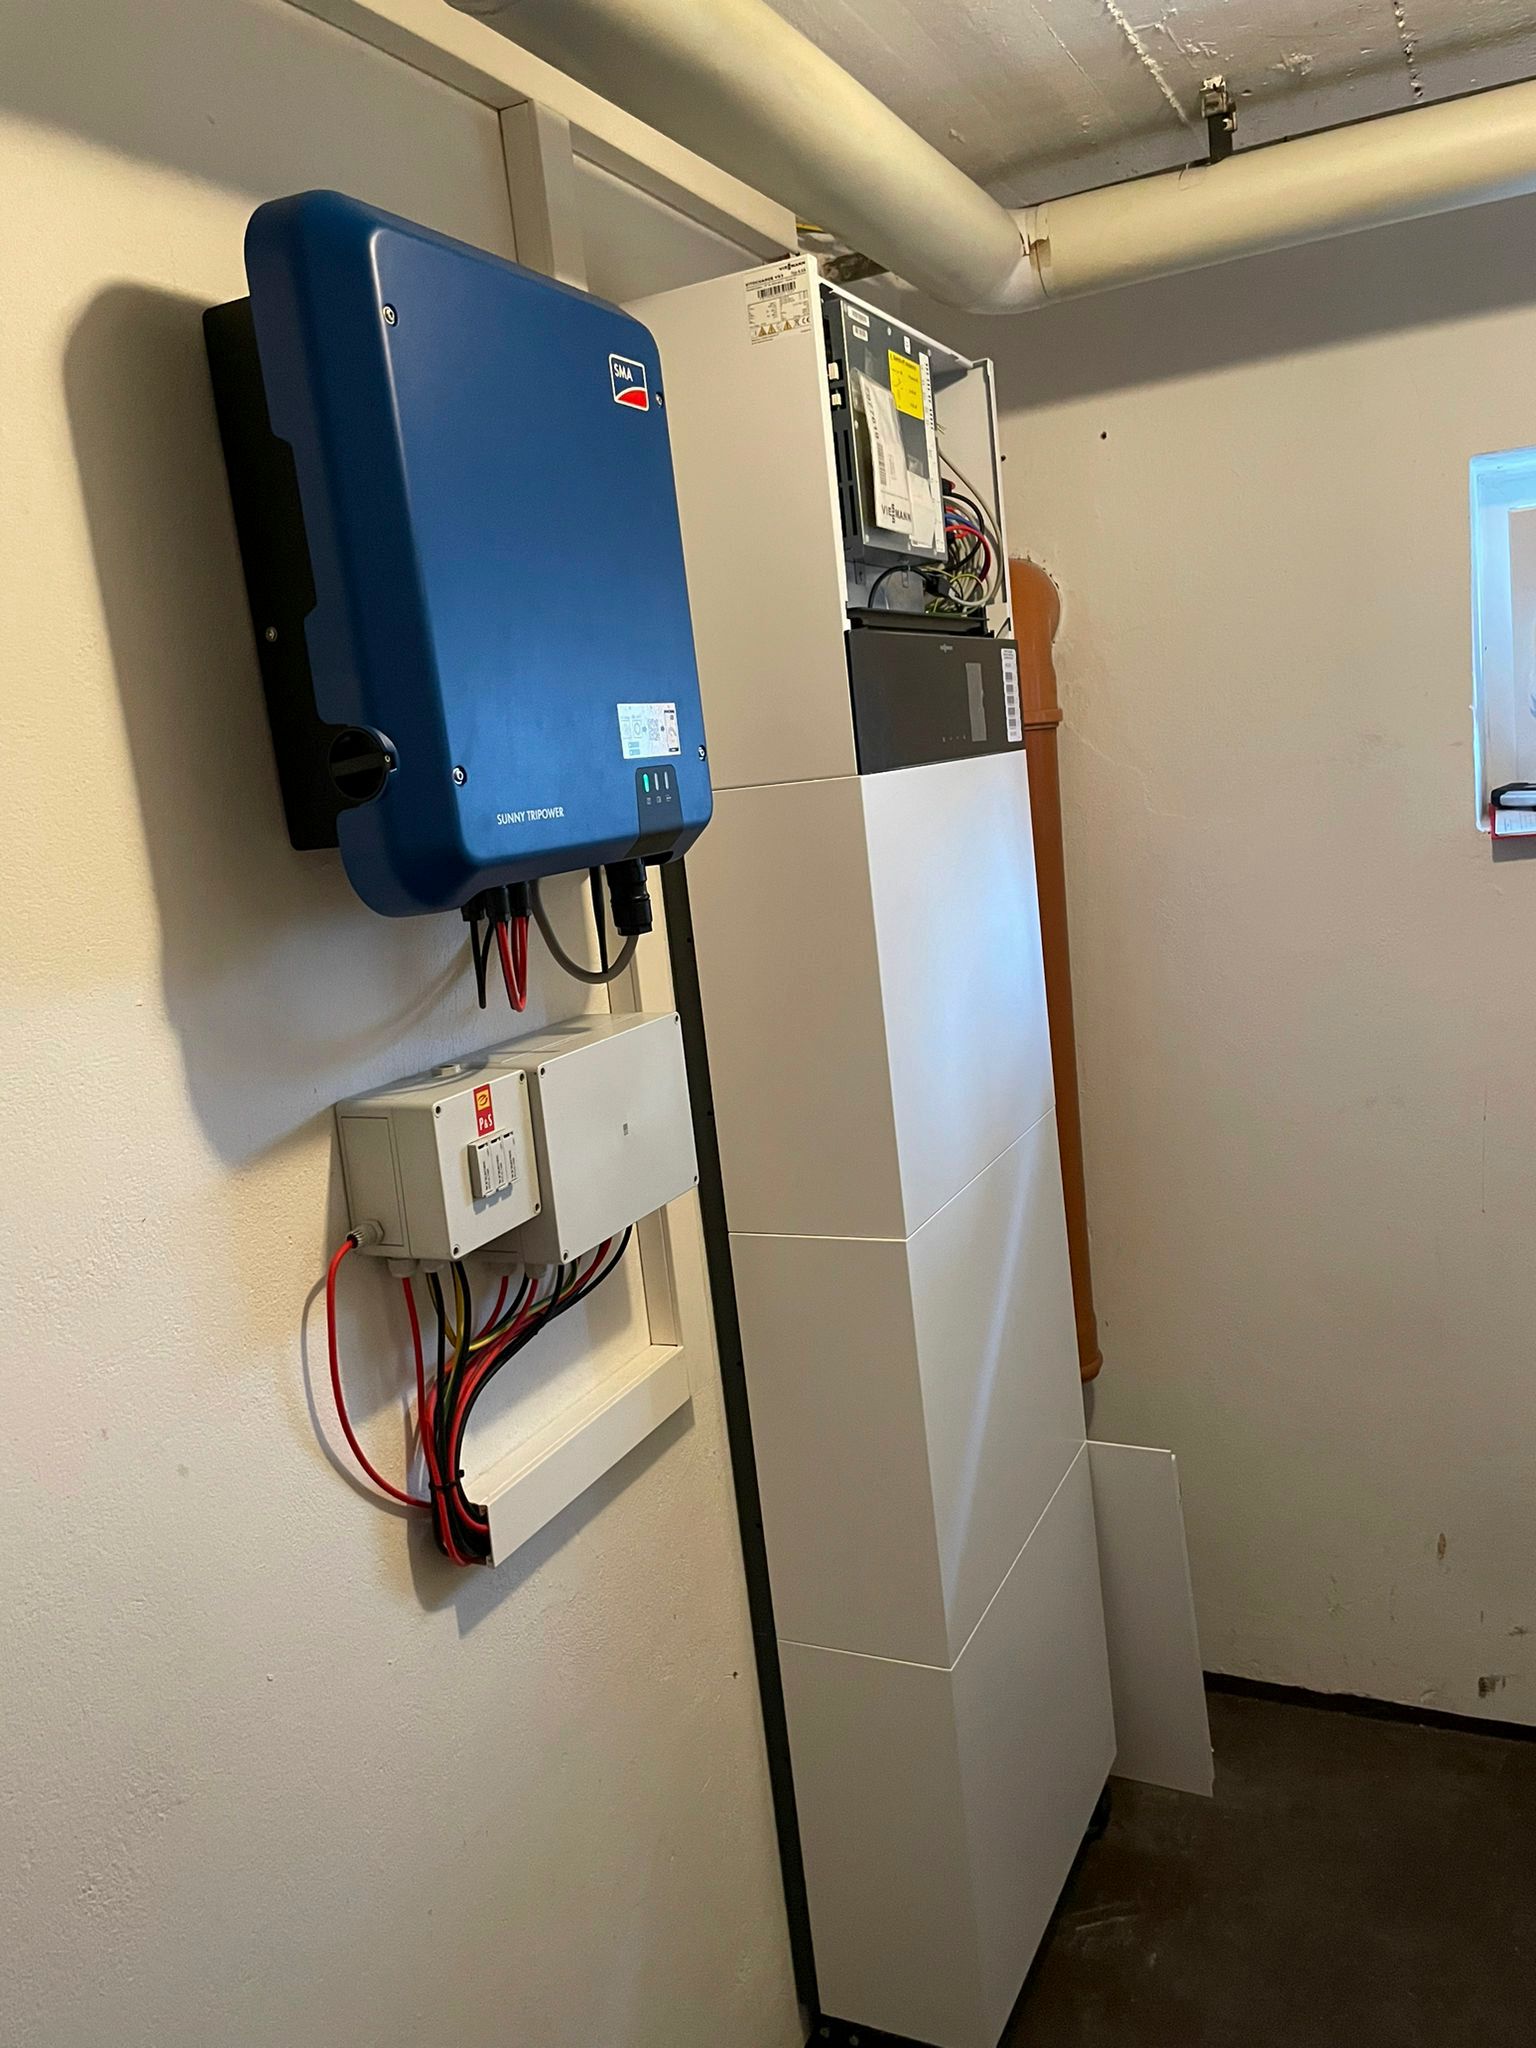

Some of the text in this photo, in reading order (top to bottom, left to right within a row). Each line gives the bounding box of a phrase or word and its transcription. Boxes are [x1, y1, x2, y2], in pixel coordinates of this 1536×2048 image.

[613, 363, 634, 382] SMA
[496, 807, 565, 825] SUNNY TRIPOWER
[479, 1113, 493, 1131] P&S
